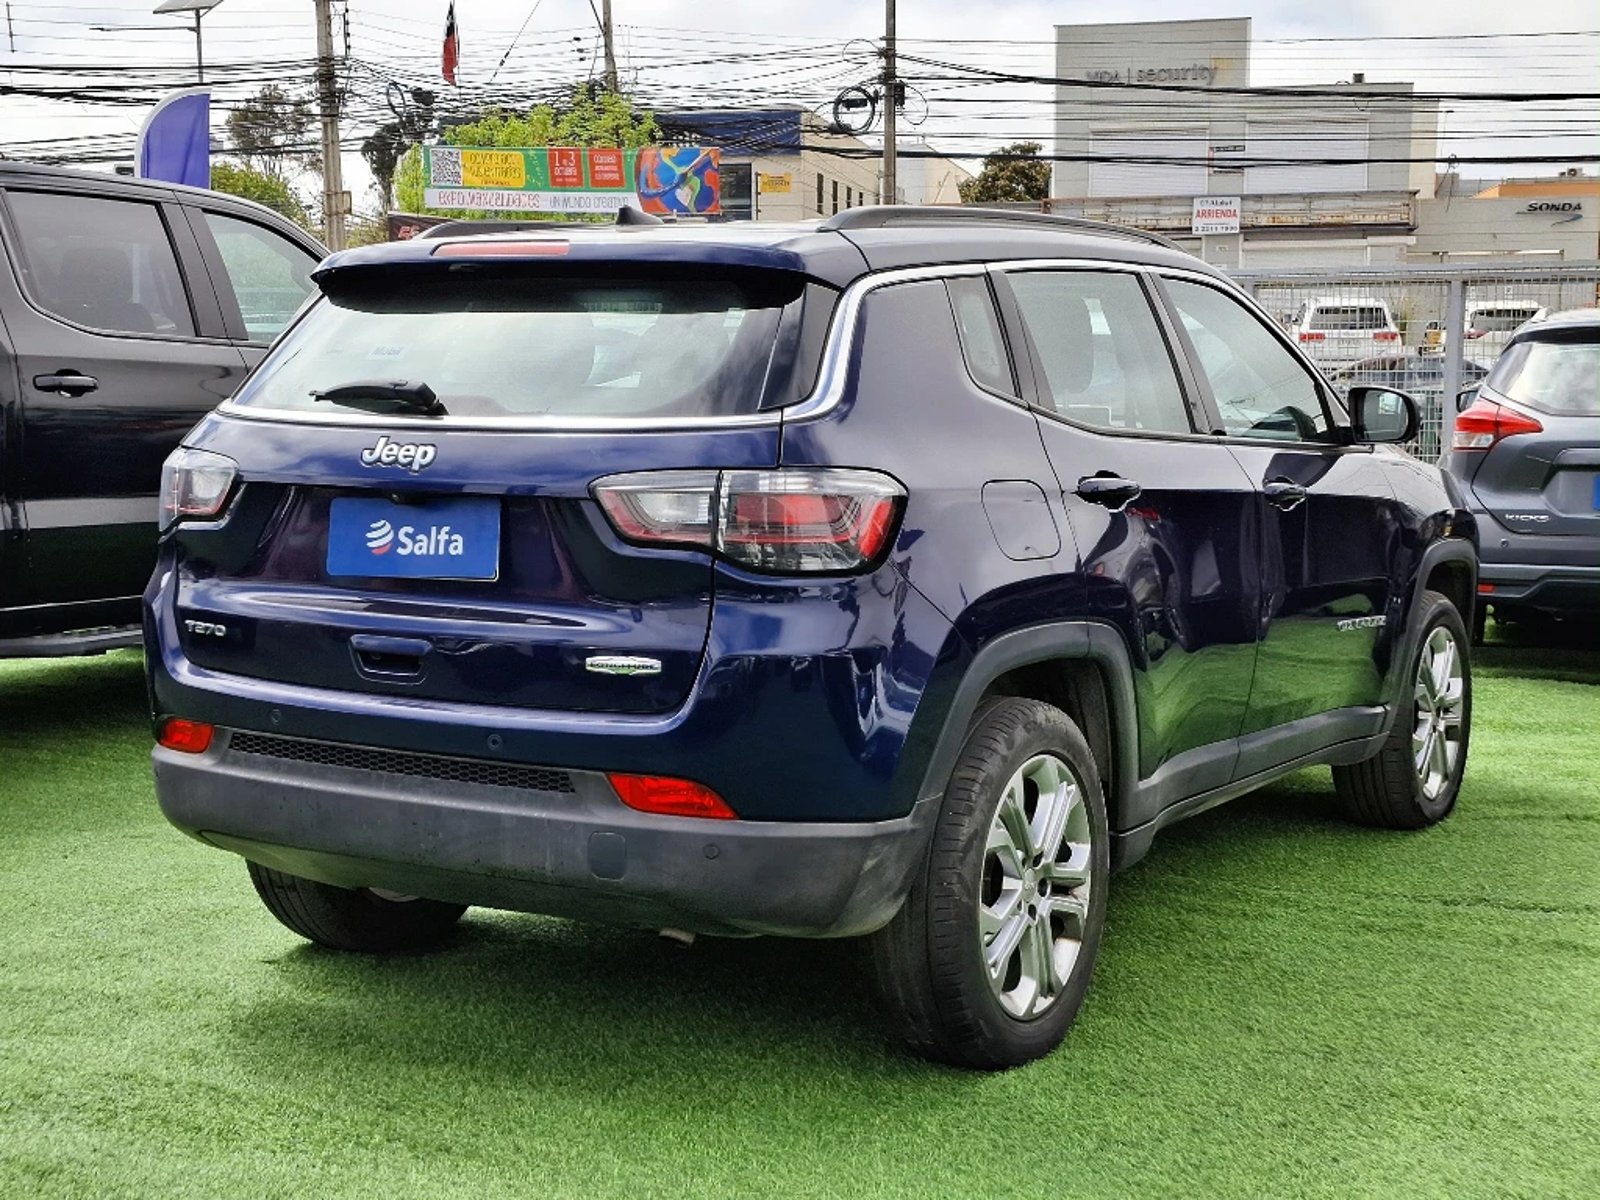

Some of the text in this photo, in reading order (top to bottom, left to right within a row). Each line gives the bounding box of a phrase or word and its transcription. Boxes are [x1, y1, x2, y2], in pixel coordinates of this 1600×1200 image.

[1137, 63, 1217, 86] security
[1195, 209, 1238, 219] ARRIENDA
[1527, 202, 1582, 212] SONDA
[361, 436, 437, 474] Jeep
[1505, 513, 1550, 523] KICKS
[396, 525, 464, 556] Salfa
[184, 619, 226, 637] T270
